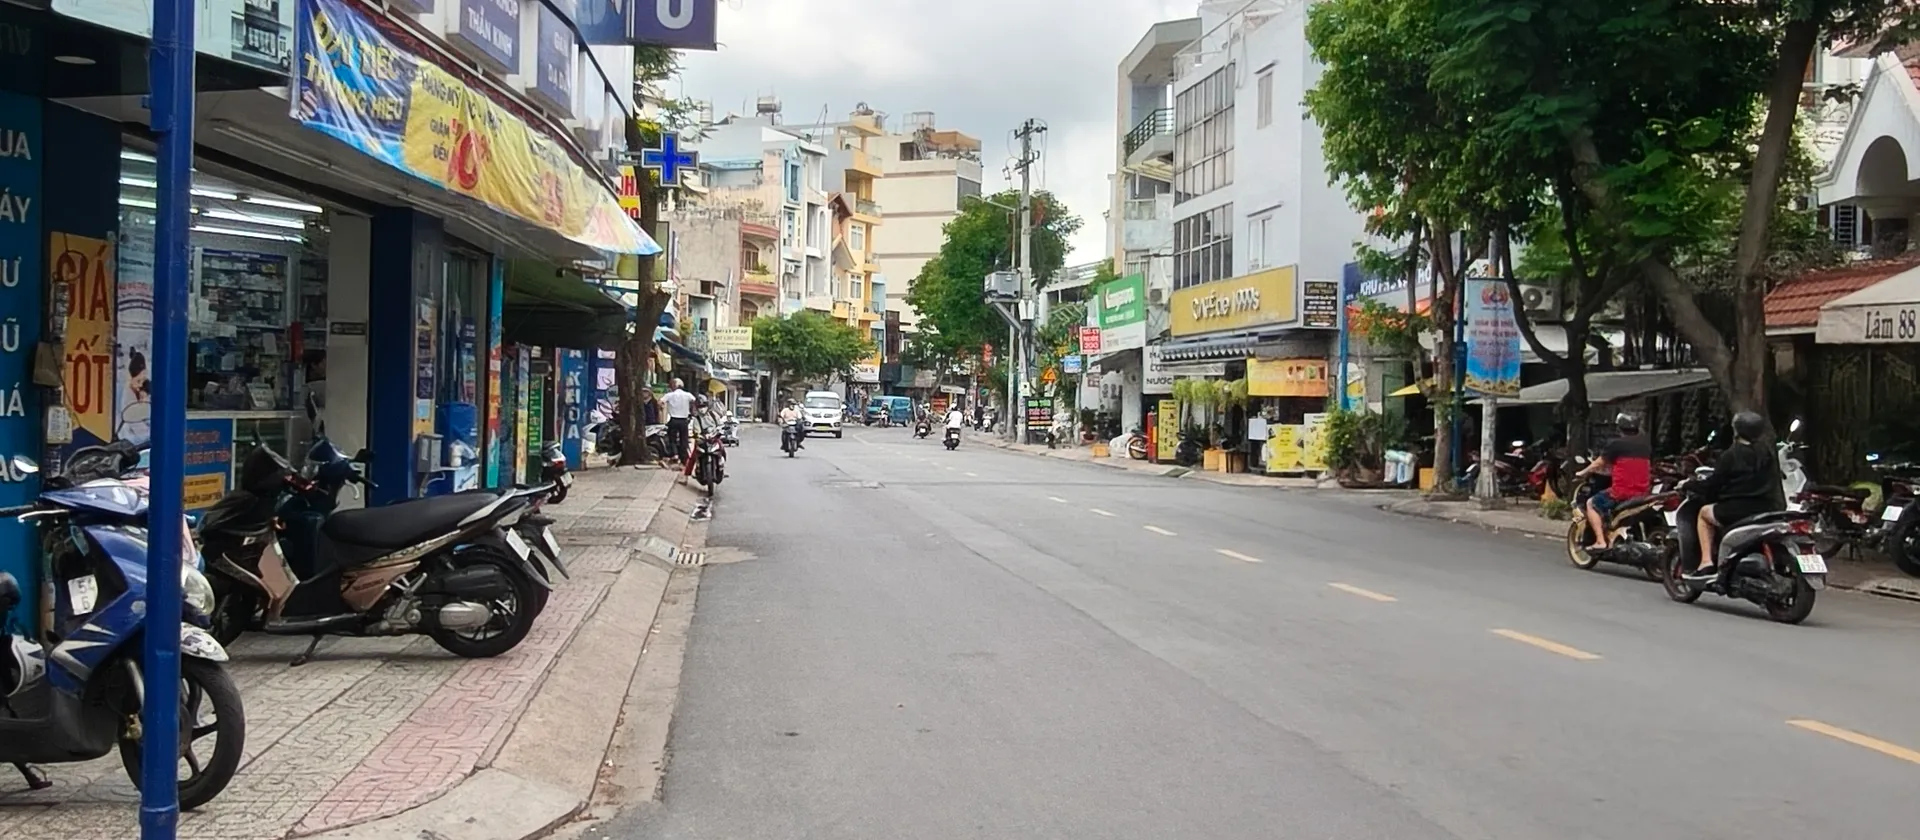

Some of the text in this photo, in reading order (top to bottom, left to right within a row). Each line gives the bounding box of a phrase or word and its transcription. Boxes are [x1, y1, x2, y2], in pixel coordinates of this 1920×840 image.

[1864, 309, 1916, 339] Lâm 88
[66, 334, 110, 415] ỐT
